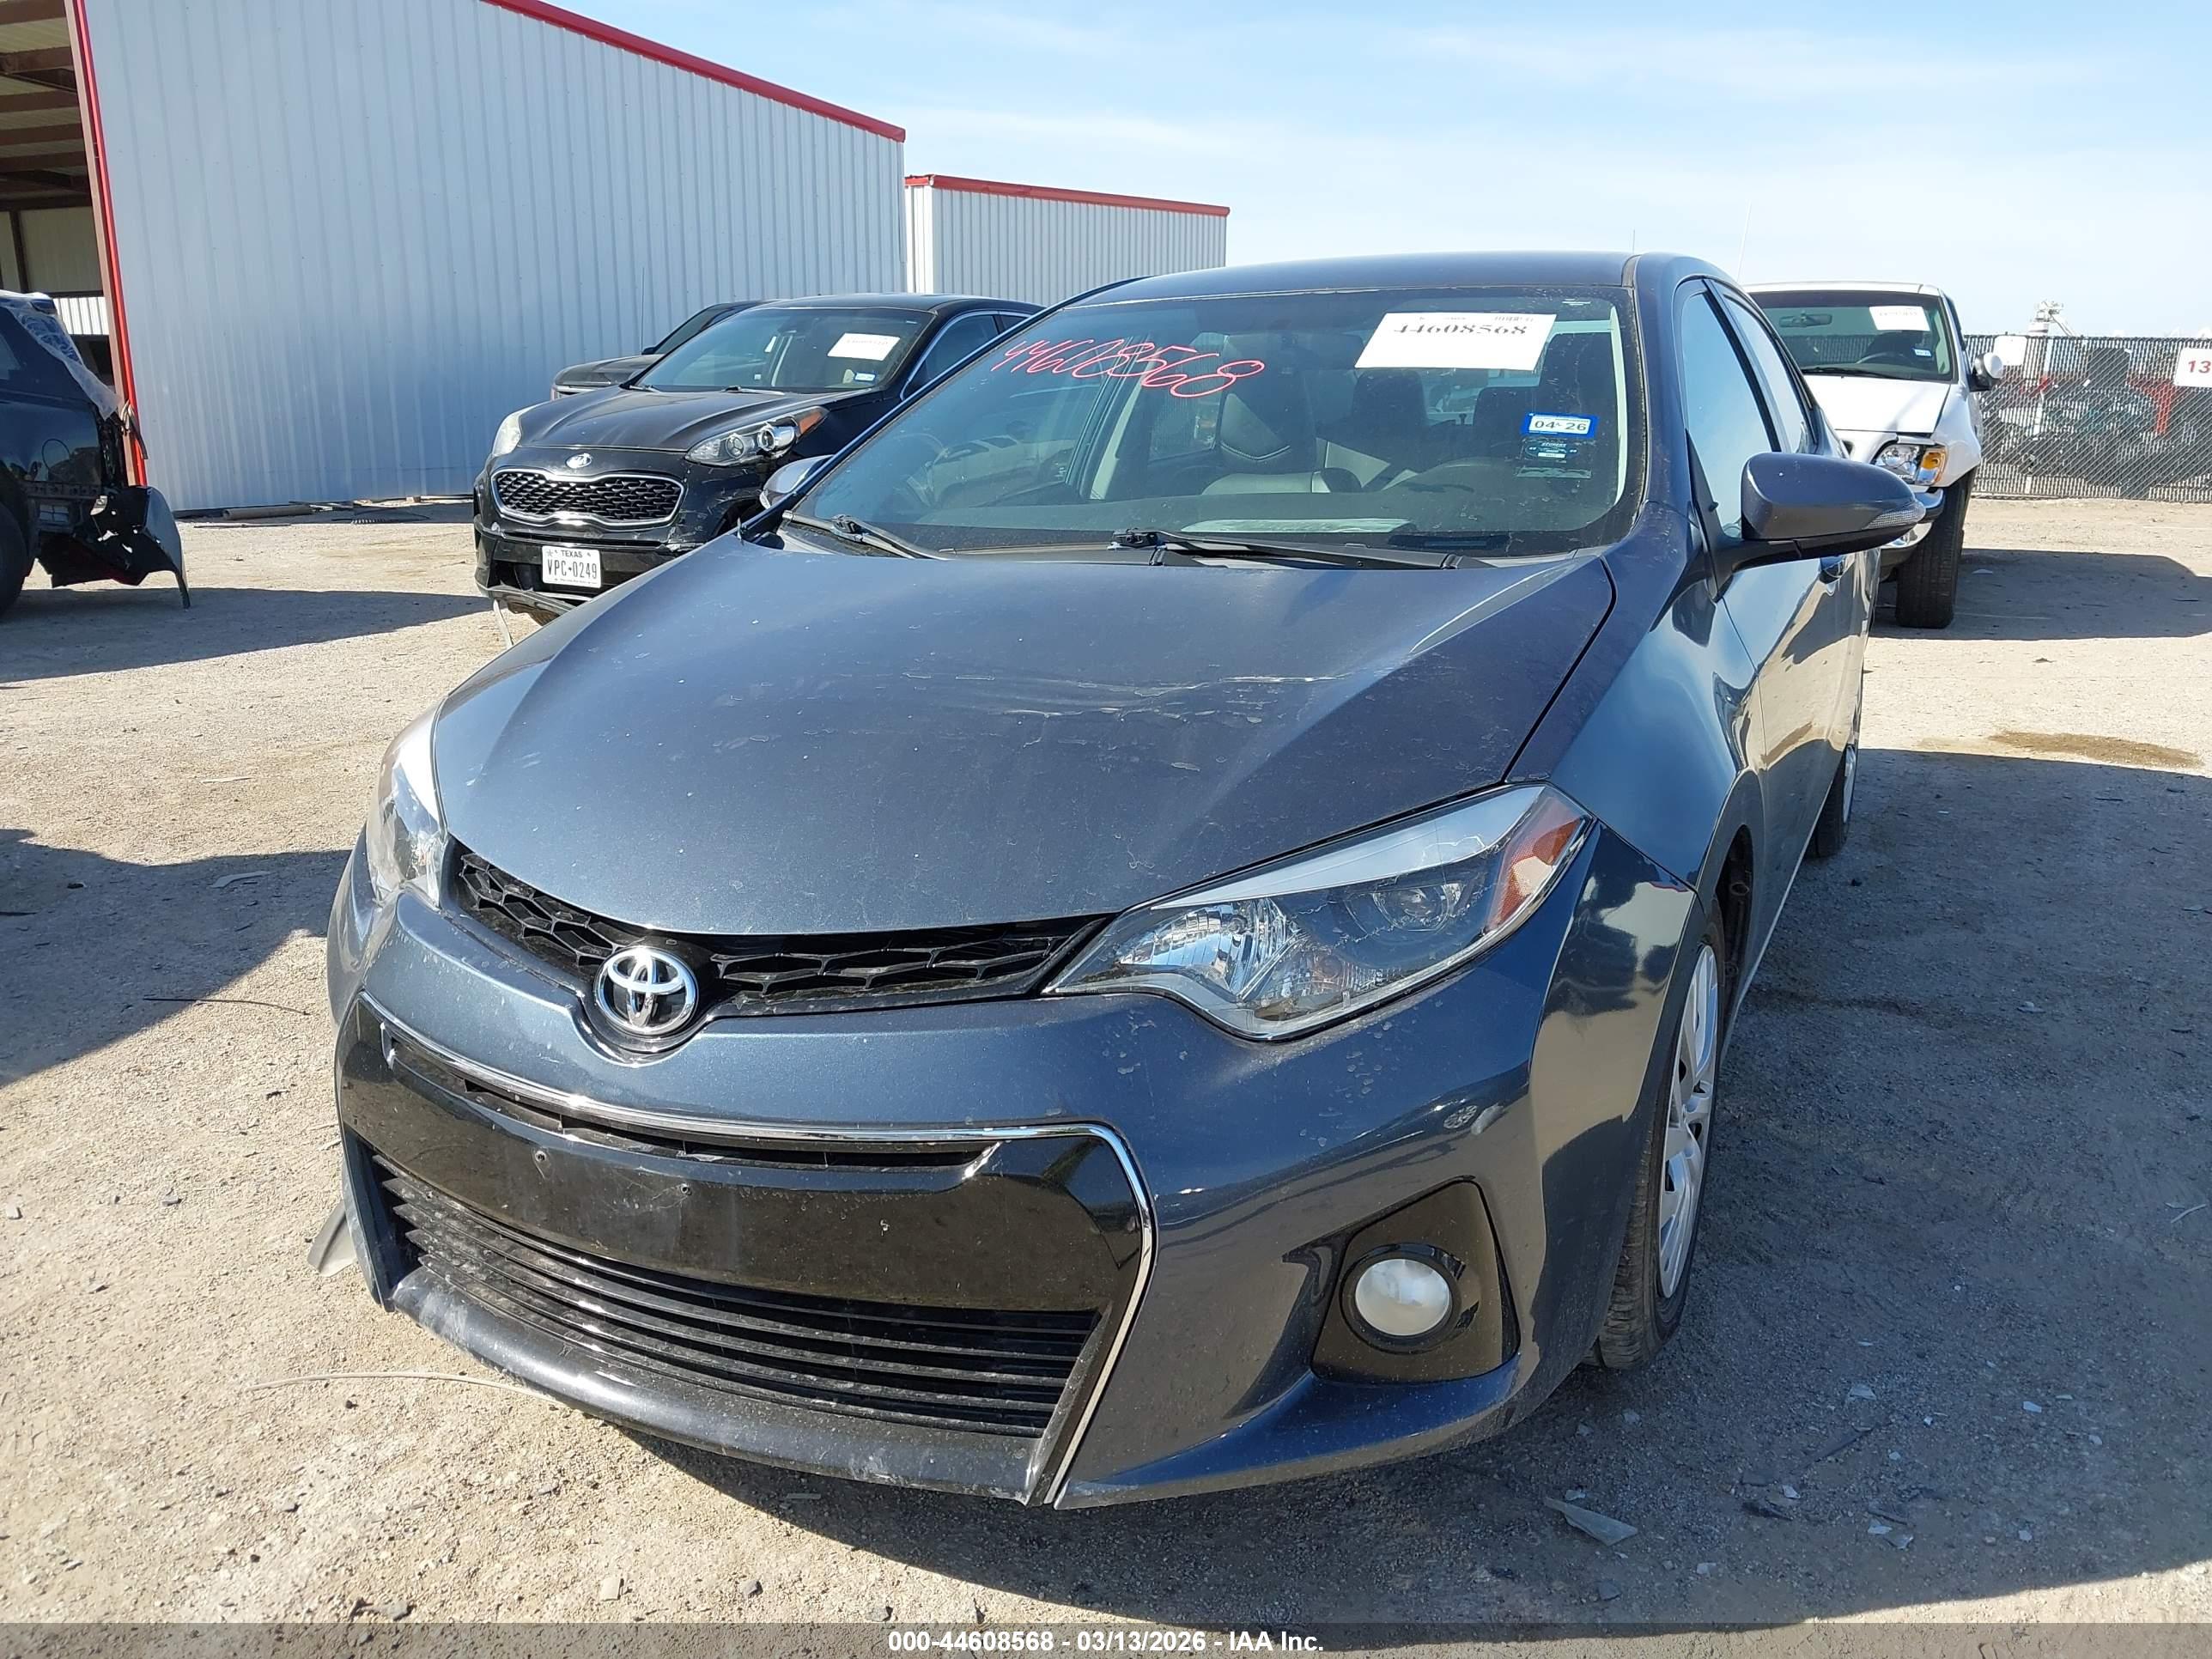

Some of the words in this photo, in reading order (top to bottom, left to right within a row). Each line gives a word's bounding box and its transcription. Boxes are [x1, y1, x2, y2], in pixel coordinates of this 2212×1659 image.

[991, 339, 1265, 397] 44608568
[2188, 360, 2211, 374] 13
[1534, 420, 1555, 429] 04
[1565, 422, 1586, 431] 26
[561, 550, 583, 558] TEXAS
